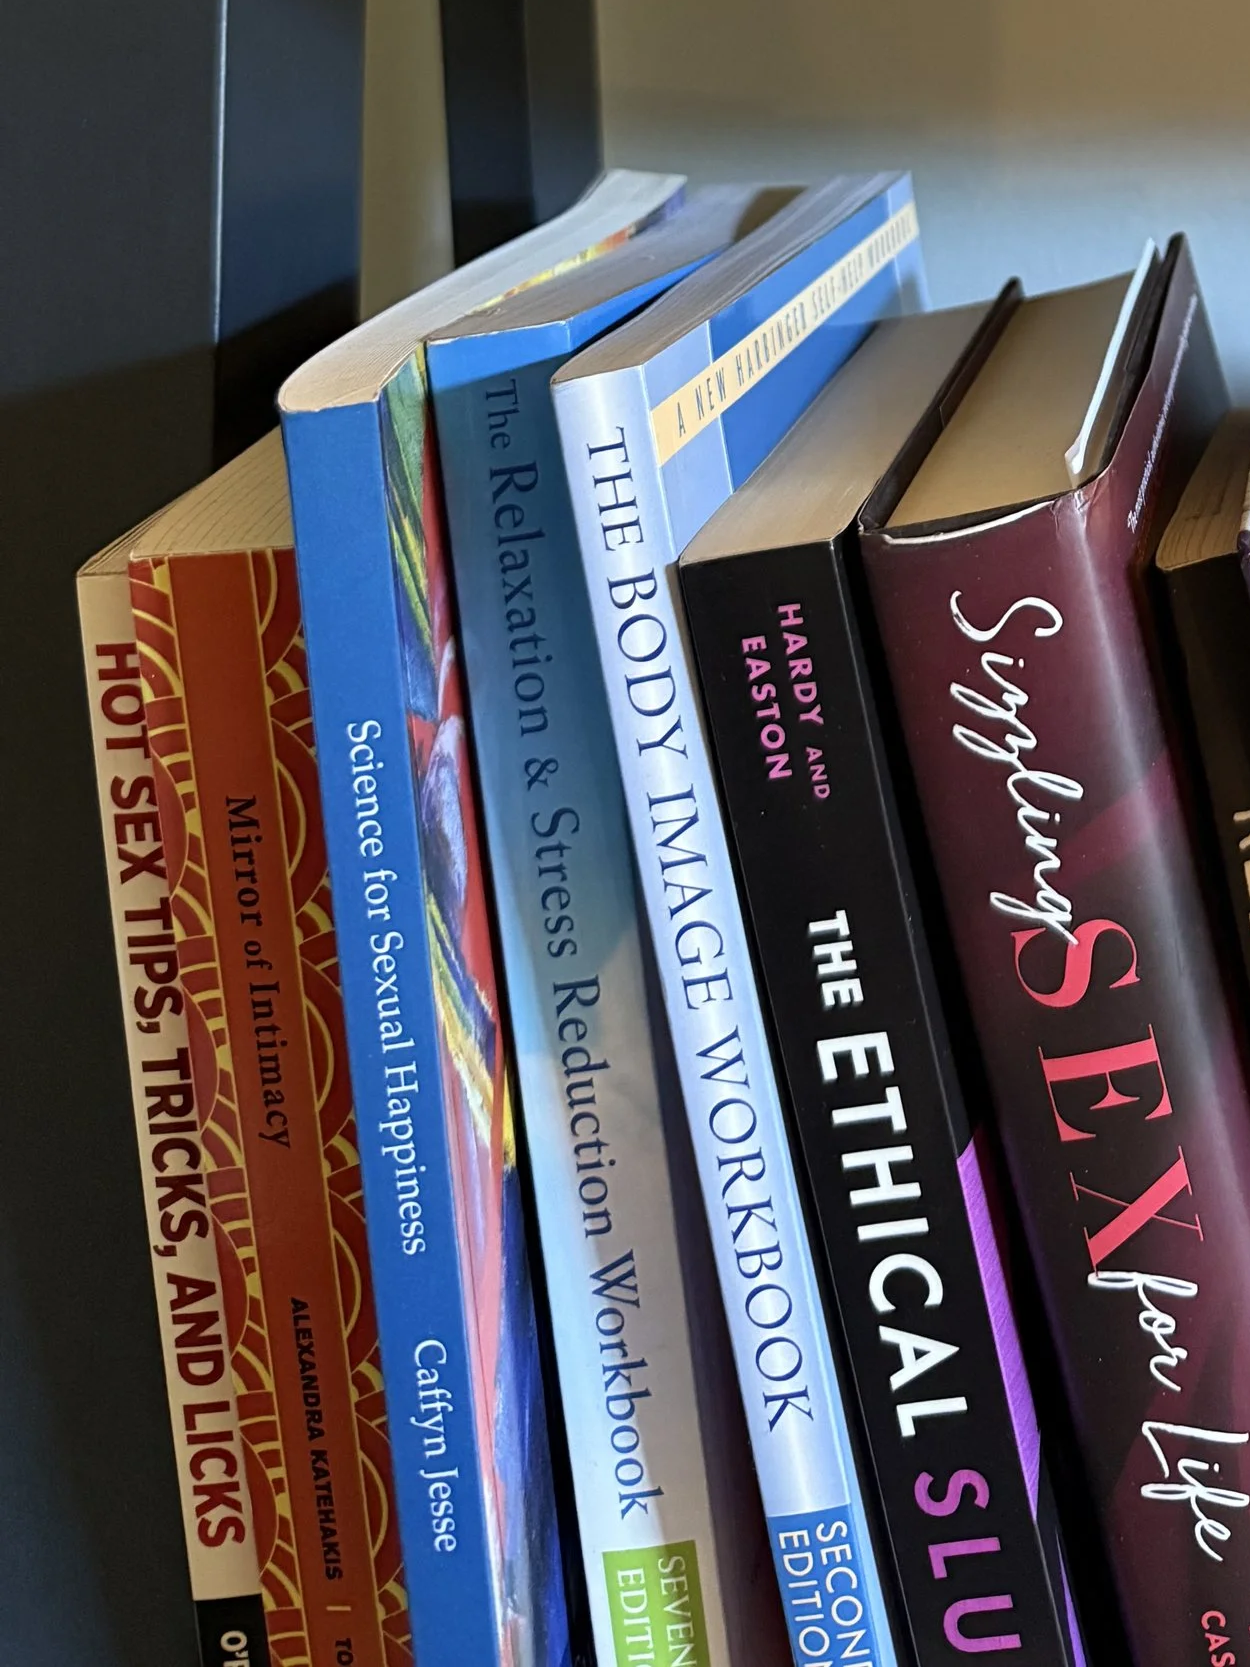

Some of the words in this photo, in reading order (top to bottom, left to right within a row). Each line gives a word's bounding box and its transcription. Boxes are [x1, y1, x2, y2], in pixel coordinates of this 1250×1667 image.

[486, 378, 520, 450] The
[677, 402, 686, 438] A
[695, 367, 727, 420] NEW
[735, 302, 806, 386] HARBINGER
[586, 426, 645, 552] THE
[489, 460, 559, 737] Relaxation
[606, 567, 689, 759] BODY
[95, 642, 150, 759] HOT
[741, 635, 793, 782] EASTON
[778, 602, 824, 726] HARDY
[806, 746, 830, 800] AND
[948, 590, 1084, 946] Sizzling
[110, 774, 167, 885] SEX
[348, 719, 384, 858] Science
[524, 757, 560, 791] &
[226, 795, 263, 927] Mirror
[362, 869, 398, 921] for
[532, 807, 581, 959] Stress
[646, 784, 737, 1010] IMAGE
[124, 896, 184, 1033] TIPS,
[242, 941, 273, 971] of
[371, 930, 416, 1054] Sexual
[808, 910, 864, 1008] THE
[248, 979, 291, 1149] Intimacy
[552, 974, 620, 1239] Reduction
[1010, 918, 1204, 1277] SEX
[141, 1047, 211, 1258] TRICKS,
[378, 1059, 426, 1255] Happiness
[695, 1024, 814, 1432] WORKBOOK
[817, 1031, 968, 1438] ETHICAL
[166, 1271, 230, 1393] AND
[409, 1339, 453, 1459] Caffyn
[589, 1248, 663, 1520] Workbook
[1088, 1271, 1199, 1392] for
[183, 1400, 245, 1547] LICKS
[290, 1297, 326, 1441] ALEXANDRA
[310, 1450, 343, 1580] KATEHAKIS
[420, 1468, 459, 1553] Jesse
[1140, 1420, 1250, 1563] Life
[914, 1468, 1022, 1653] SLU
